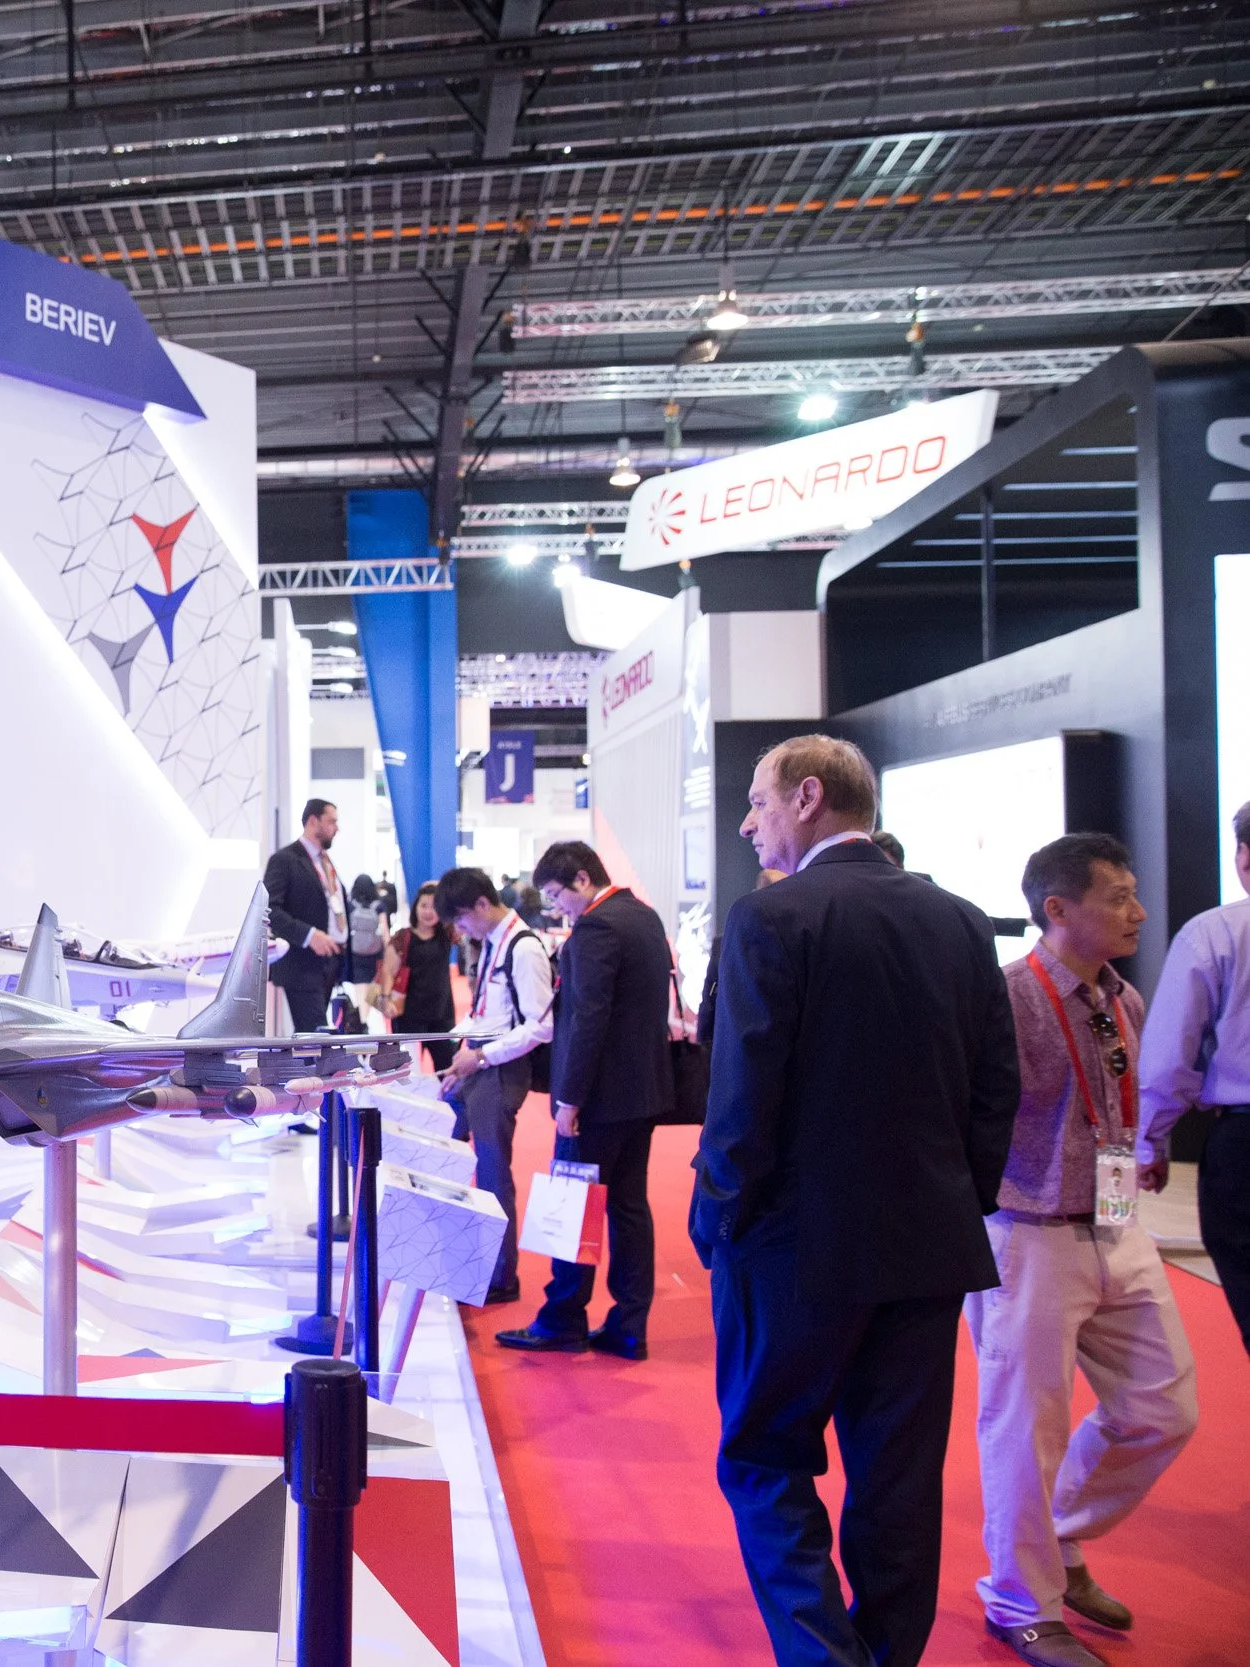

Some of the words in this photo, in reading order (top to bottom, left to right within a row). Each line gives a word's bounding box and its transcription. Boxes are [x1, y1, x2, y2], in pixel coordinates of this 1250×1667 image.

[25, 292, 117, 346] BERIEV
[699, 435, 946, 524] LEONARDO
[498, 753, 516, 793] J
[109, 979, 132, 998] 01
